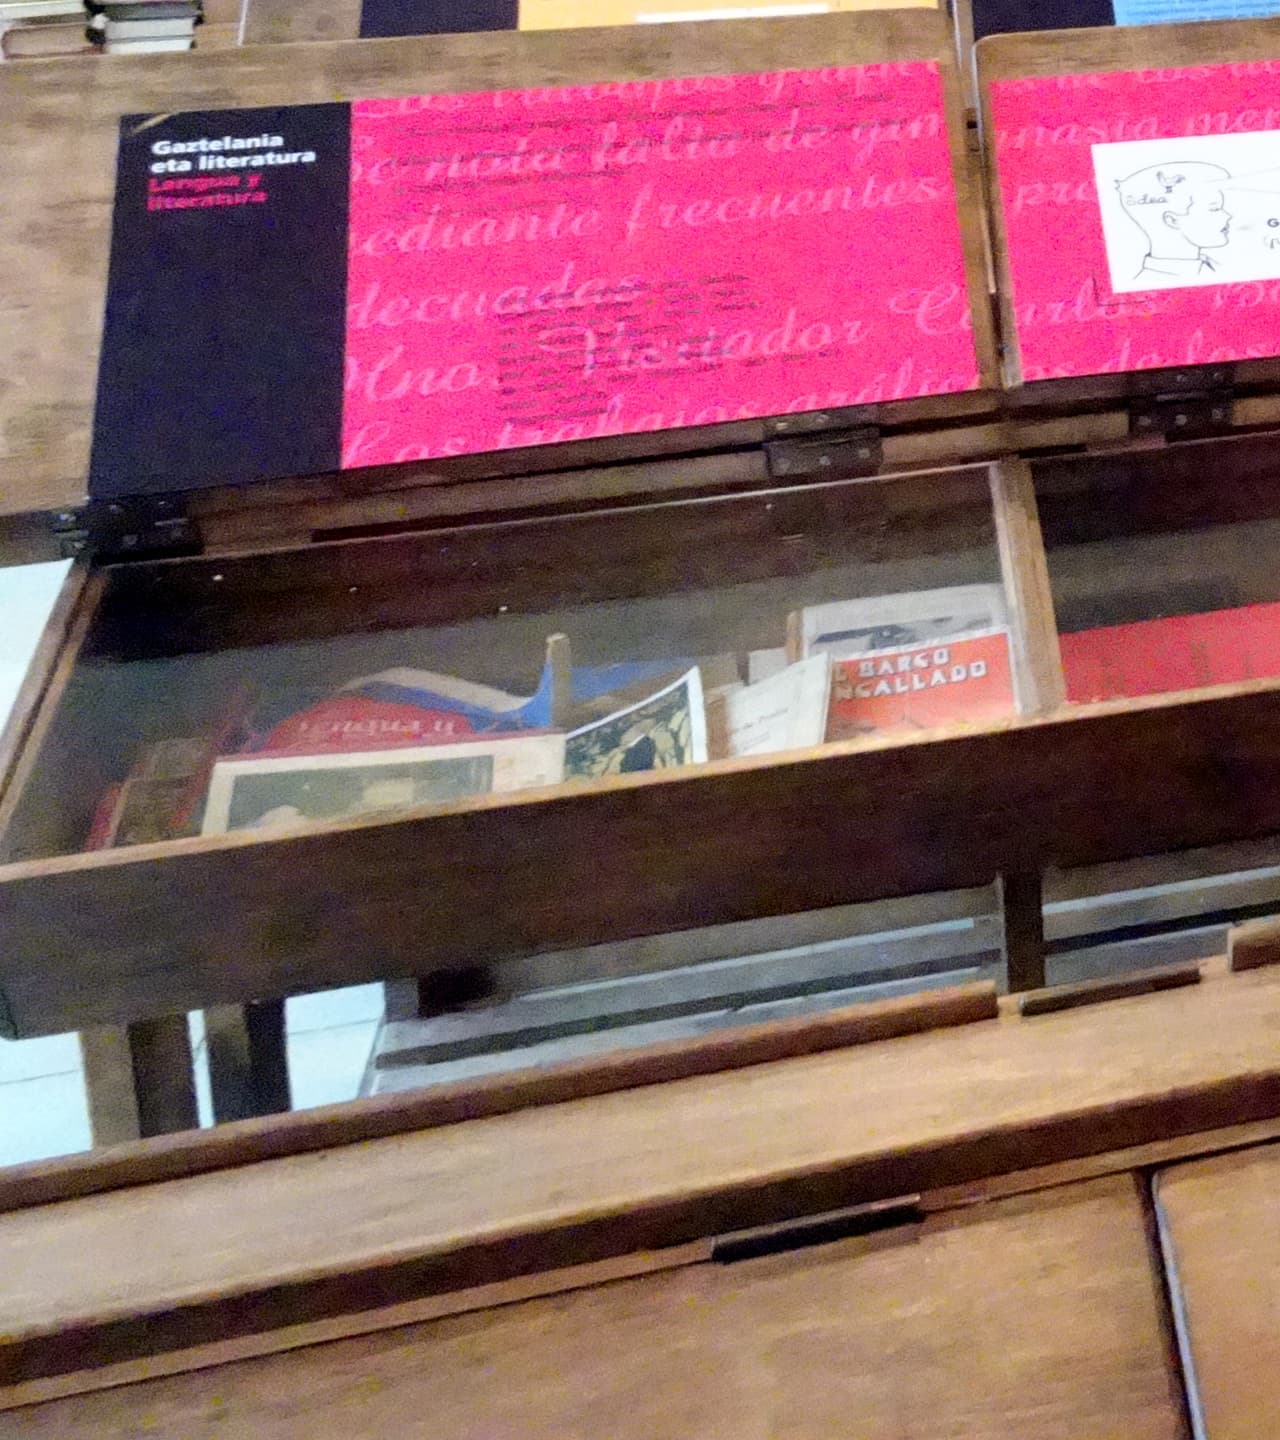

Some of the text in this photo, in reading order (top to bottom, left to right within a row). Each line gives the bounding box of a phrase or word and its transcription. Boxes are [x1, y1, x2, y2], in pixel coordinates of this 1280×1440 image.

[151, 133, 285, 155] Gaztelania
[150, 151, 317, 174] eta literatura
[346, 203, 603, 257] ediante
[858, 648, 951, 679] BARCO
[832, 659, 989, 702] NCALLADO
